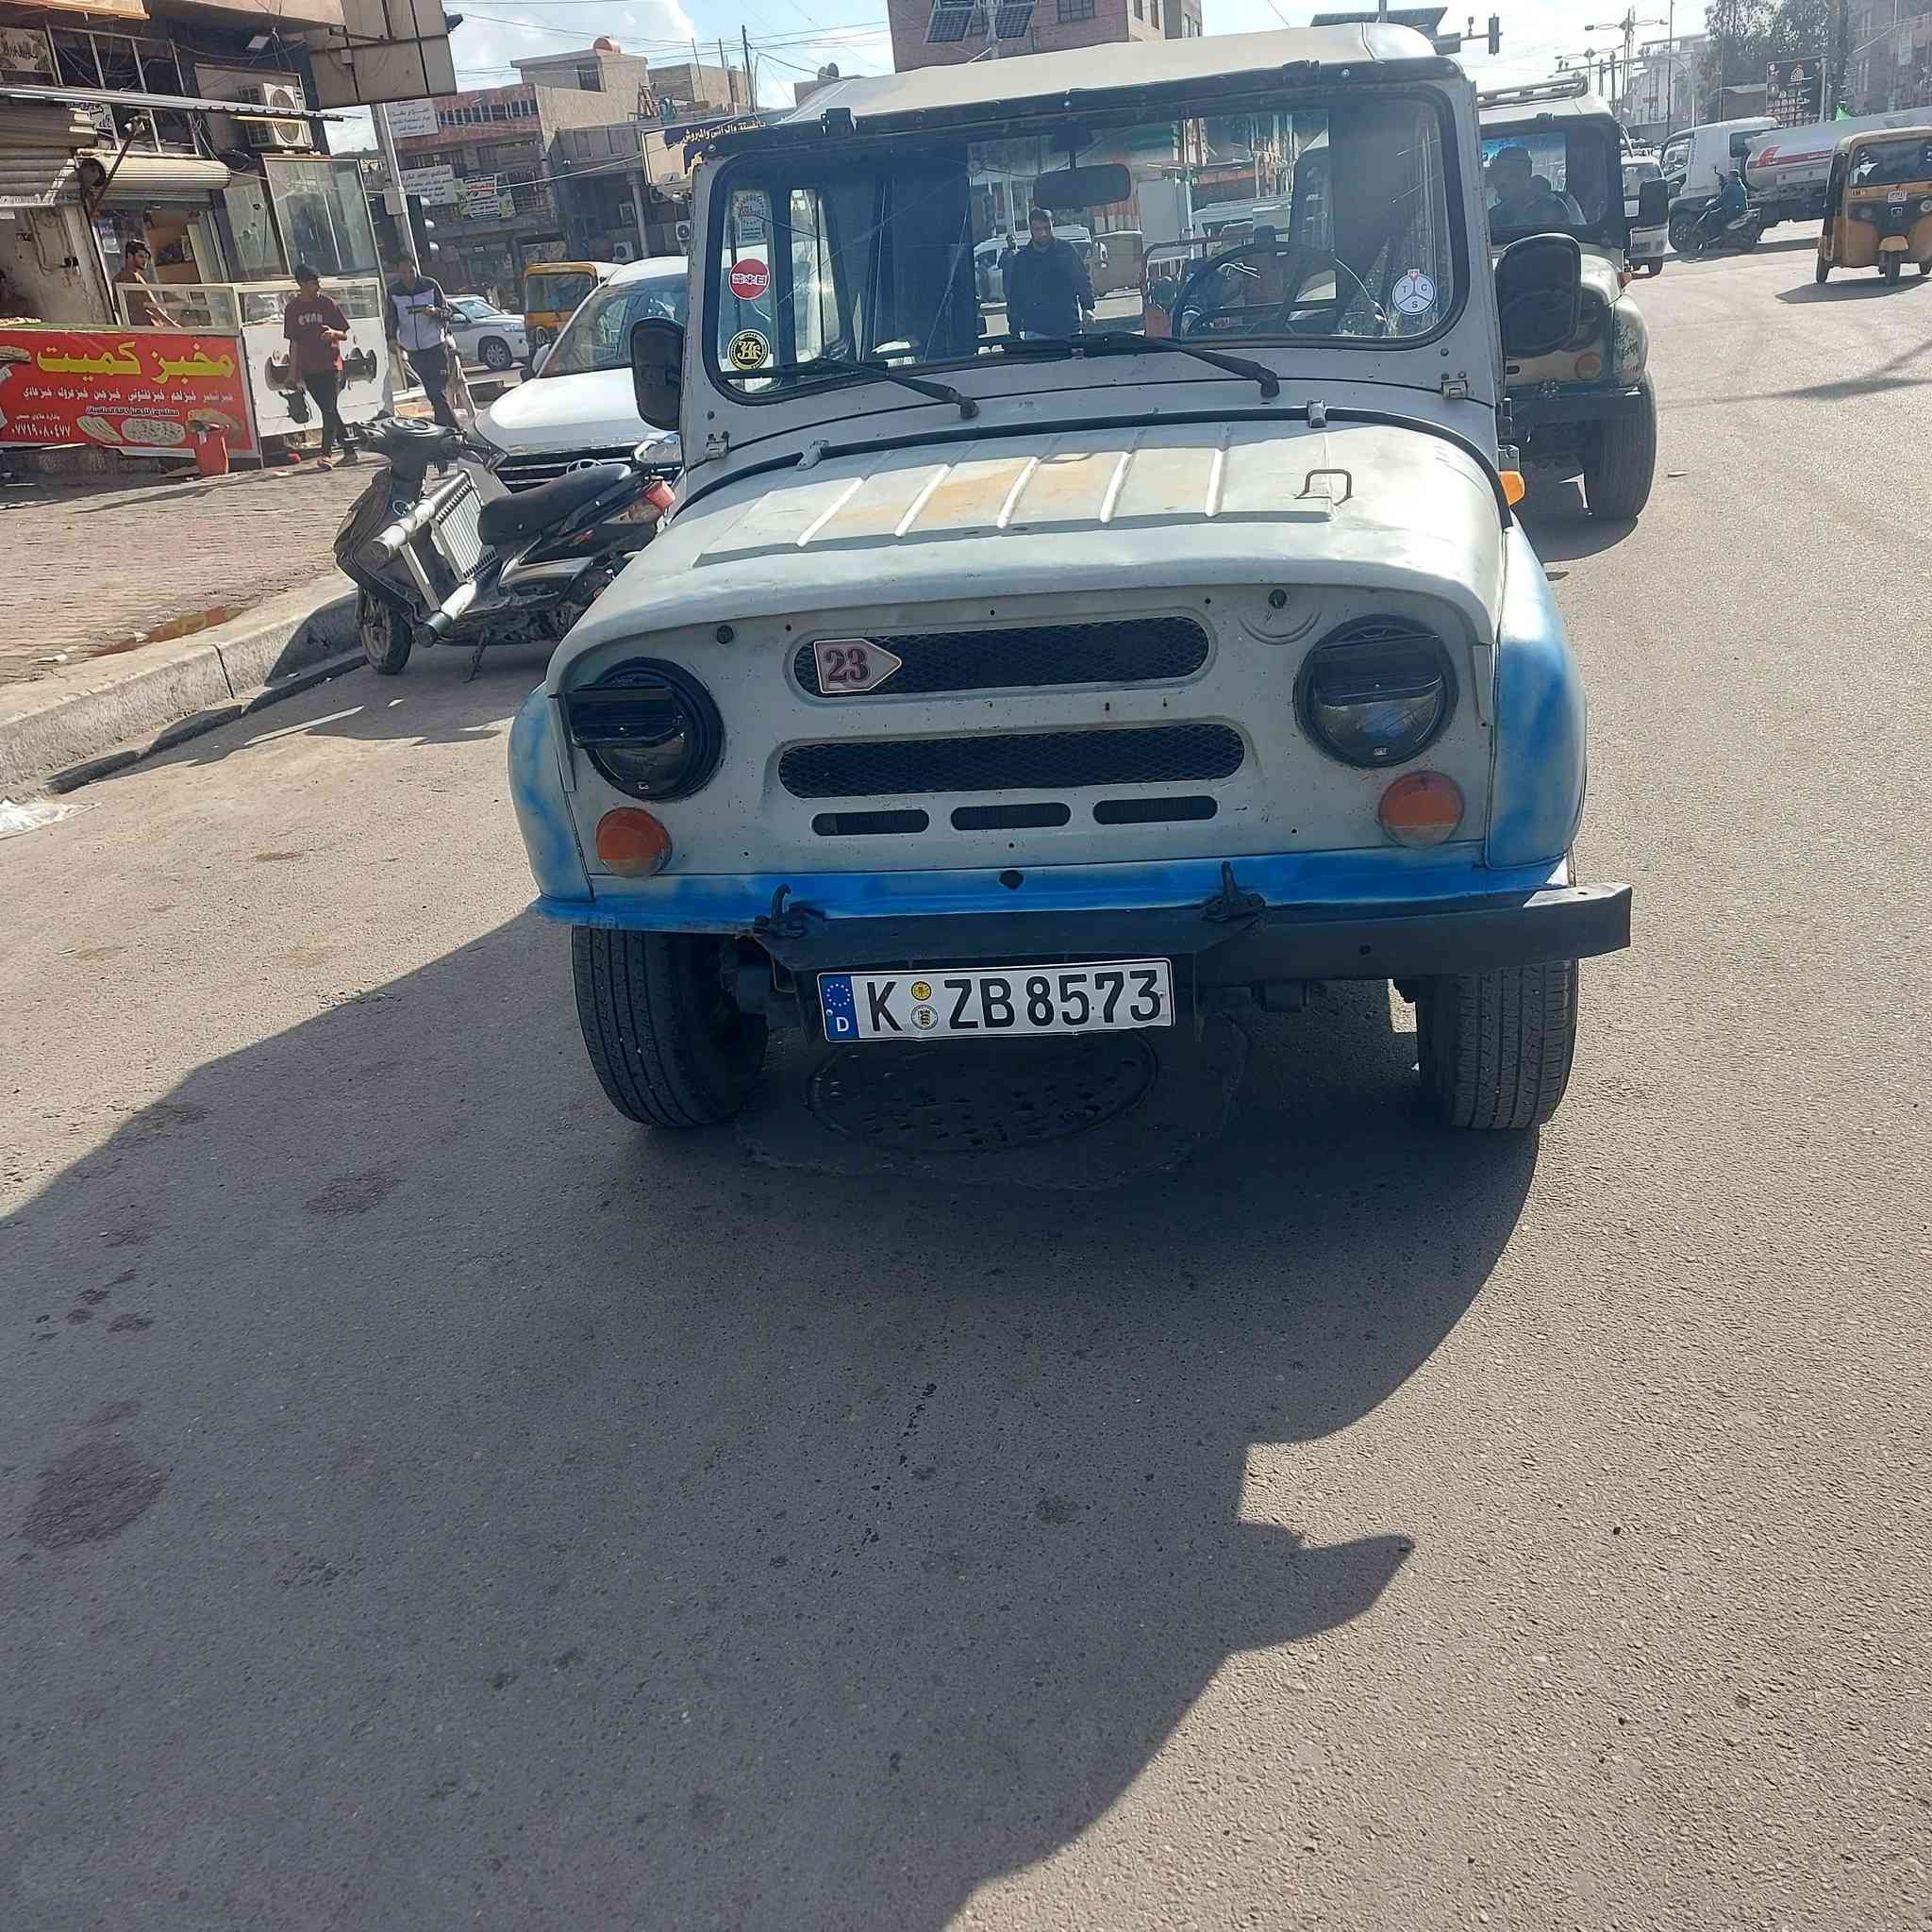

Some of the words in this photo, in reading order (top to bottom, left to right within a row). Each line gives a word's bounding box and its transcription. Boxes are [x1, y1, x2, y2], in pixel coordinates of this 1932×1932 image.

[1401, 285, 1408, 294] T
[36, 341, 142, 381] كميت
[151, 342, 236, 384] مخبز
[836, 1016, 849, 1033] D
[865, 981, 903, 1032] K
